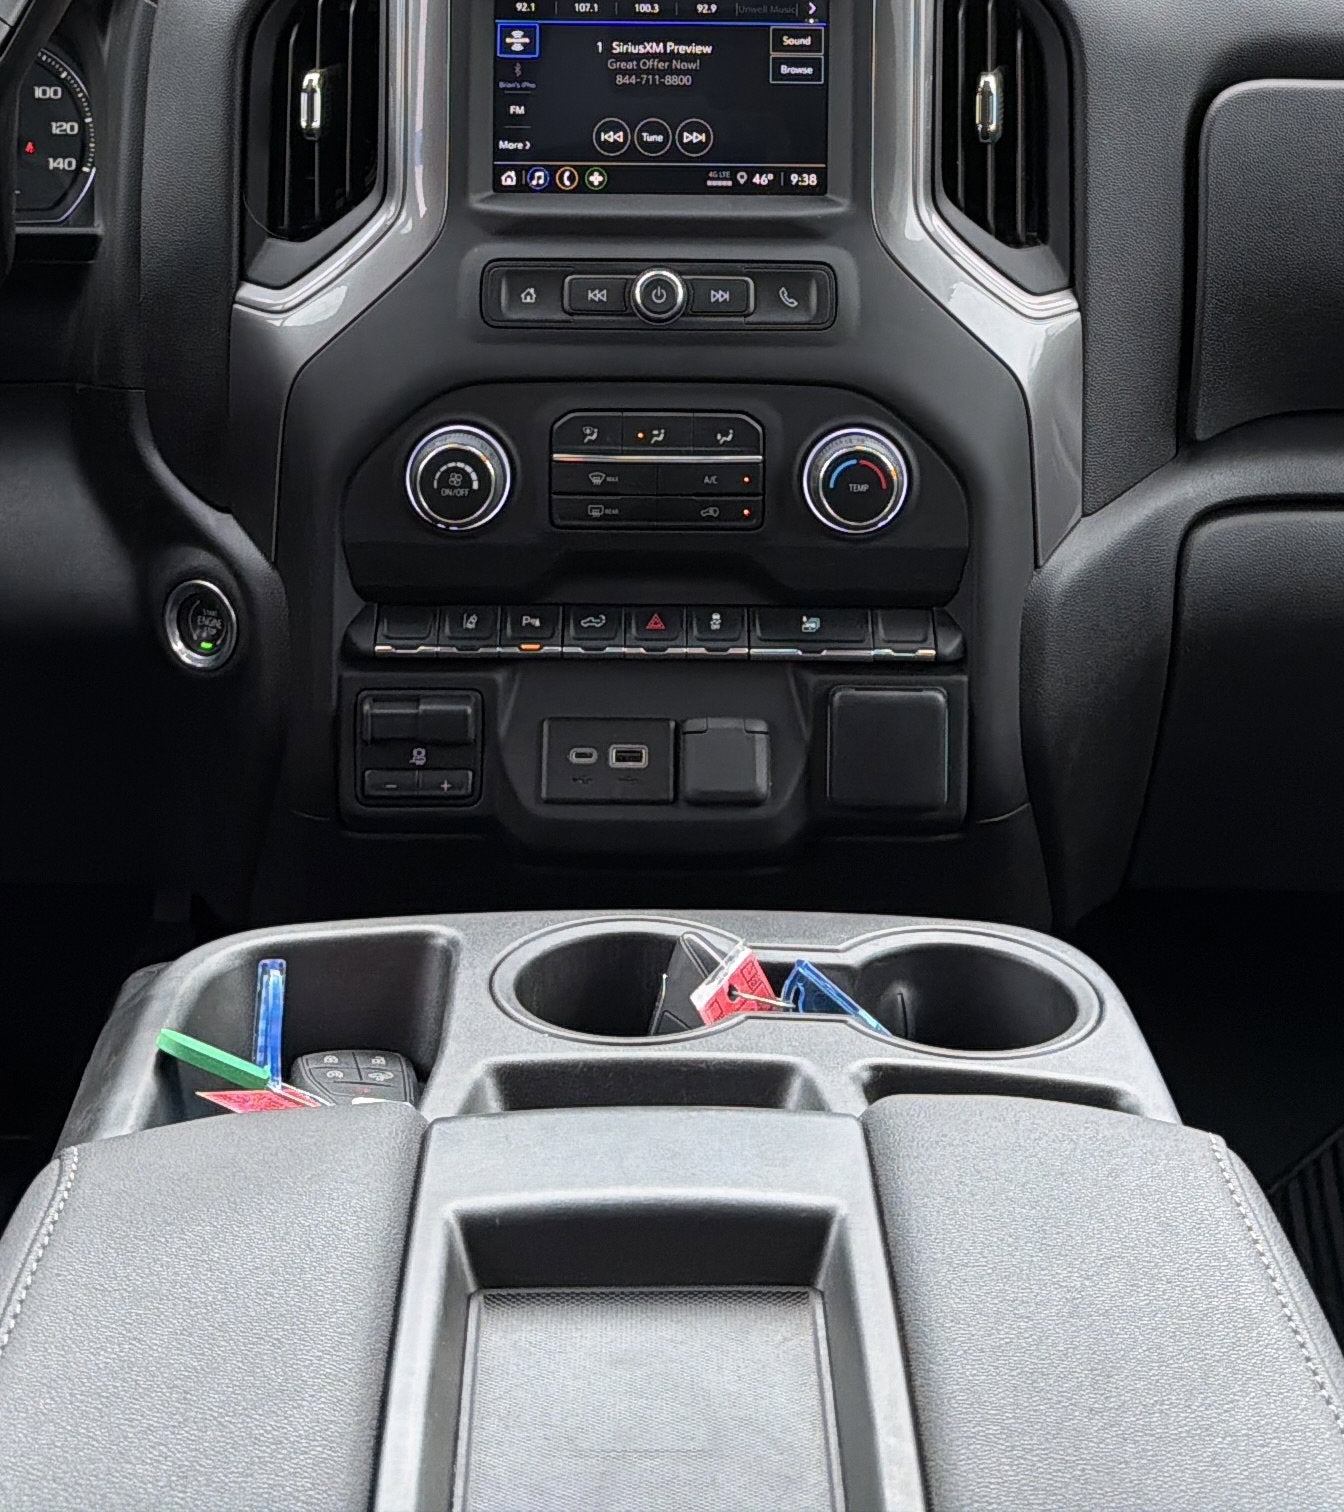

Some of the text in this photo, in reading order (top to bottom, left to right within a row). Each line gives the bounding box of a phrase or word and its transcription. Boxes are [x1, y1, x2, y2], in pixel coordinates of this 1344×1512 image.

[515, 2, 536, 12] 92.1
[574, 2, 598, 13] 107.1
[634, 3, 659, 13] 100.3
[696, 3, 718, 13] 92.9
[769, 5, 797, 14] Music
[782, 36, 812, 46] Sound
[611, 41, 664, 54] SiriusXM
[666, 42, 713, 54] Preview
[607, 59, 700, 70] Great Offer Now!
[780, 65, 813, 75] Browse
[615, 75, 692, 86] 844-711-8800
[33, 86, 62, 99] 100
[509, 106, 525, 115] FM
[51, 122, 79, 135] 120
[641, 133, 663, 142] Tune
[498, 140, 524, 150] More
[48, 157, 76, 170] 140
[790, 174, 818, 186] 9:38
[704, 475, 718, 485] A/C
[441, 487, 470, 498] ON/OFF
[849, 483, 870, 494] TEMP
